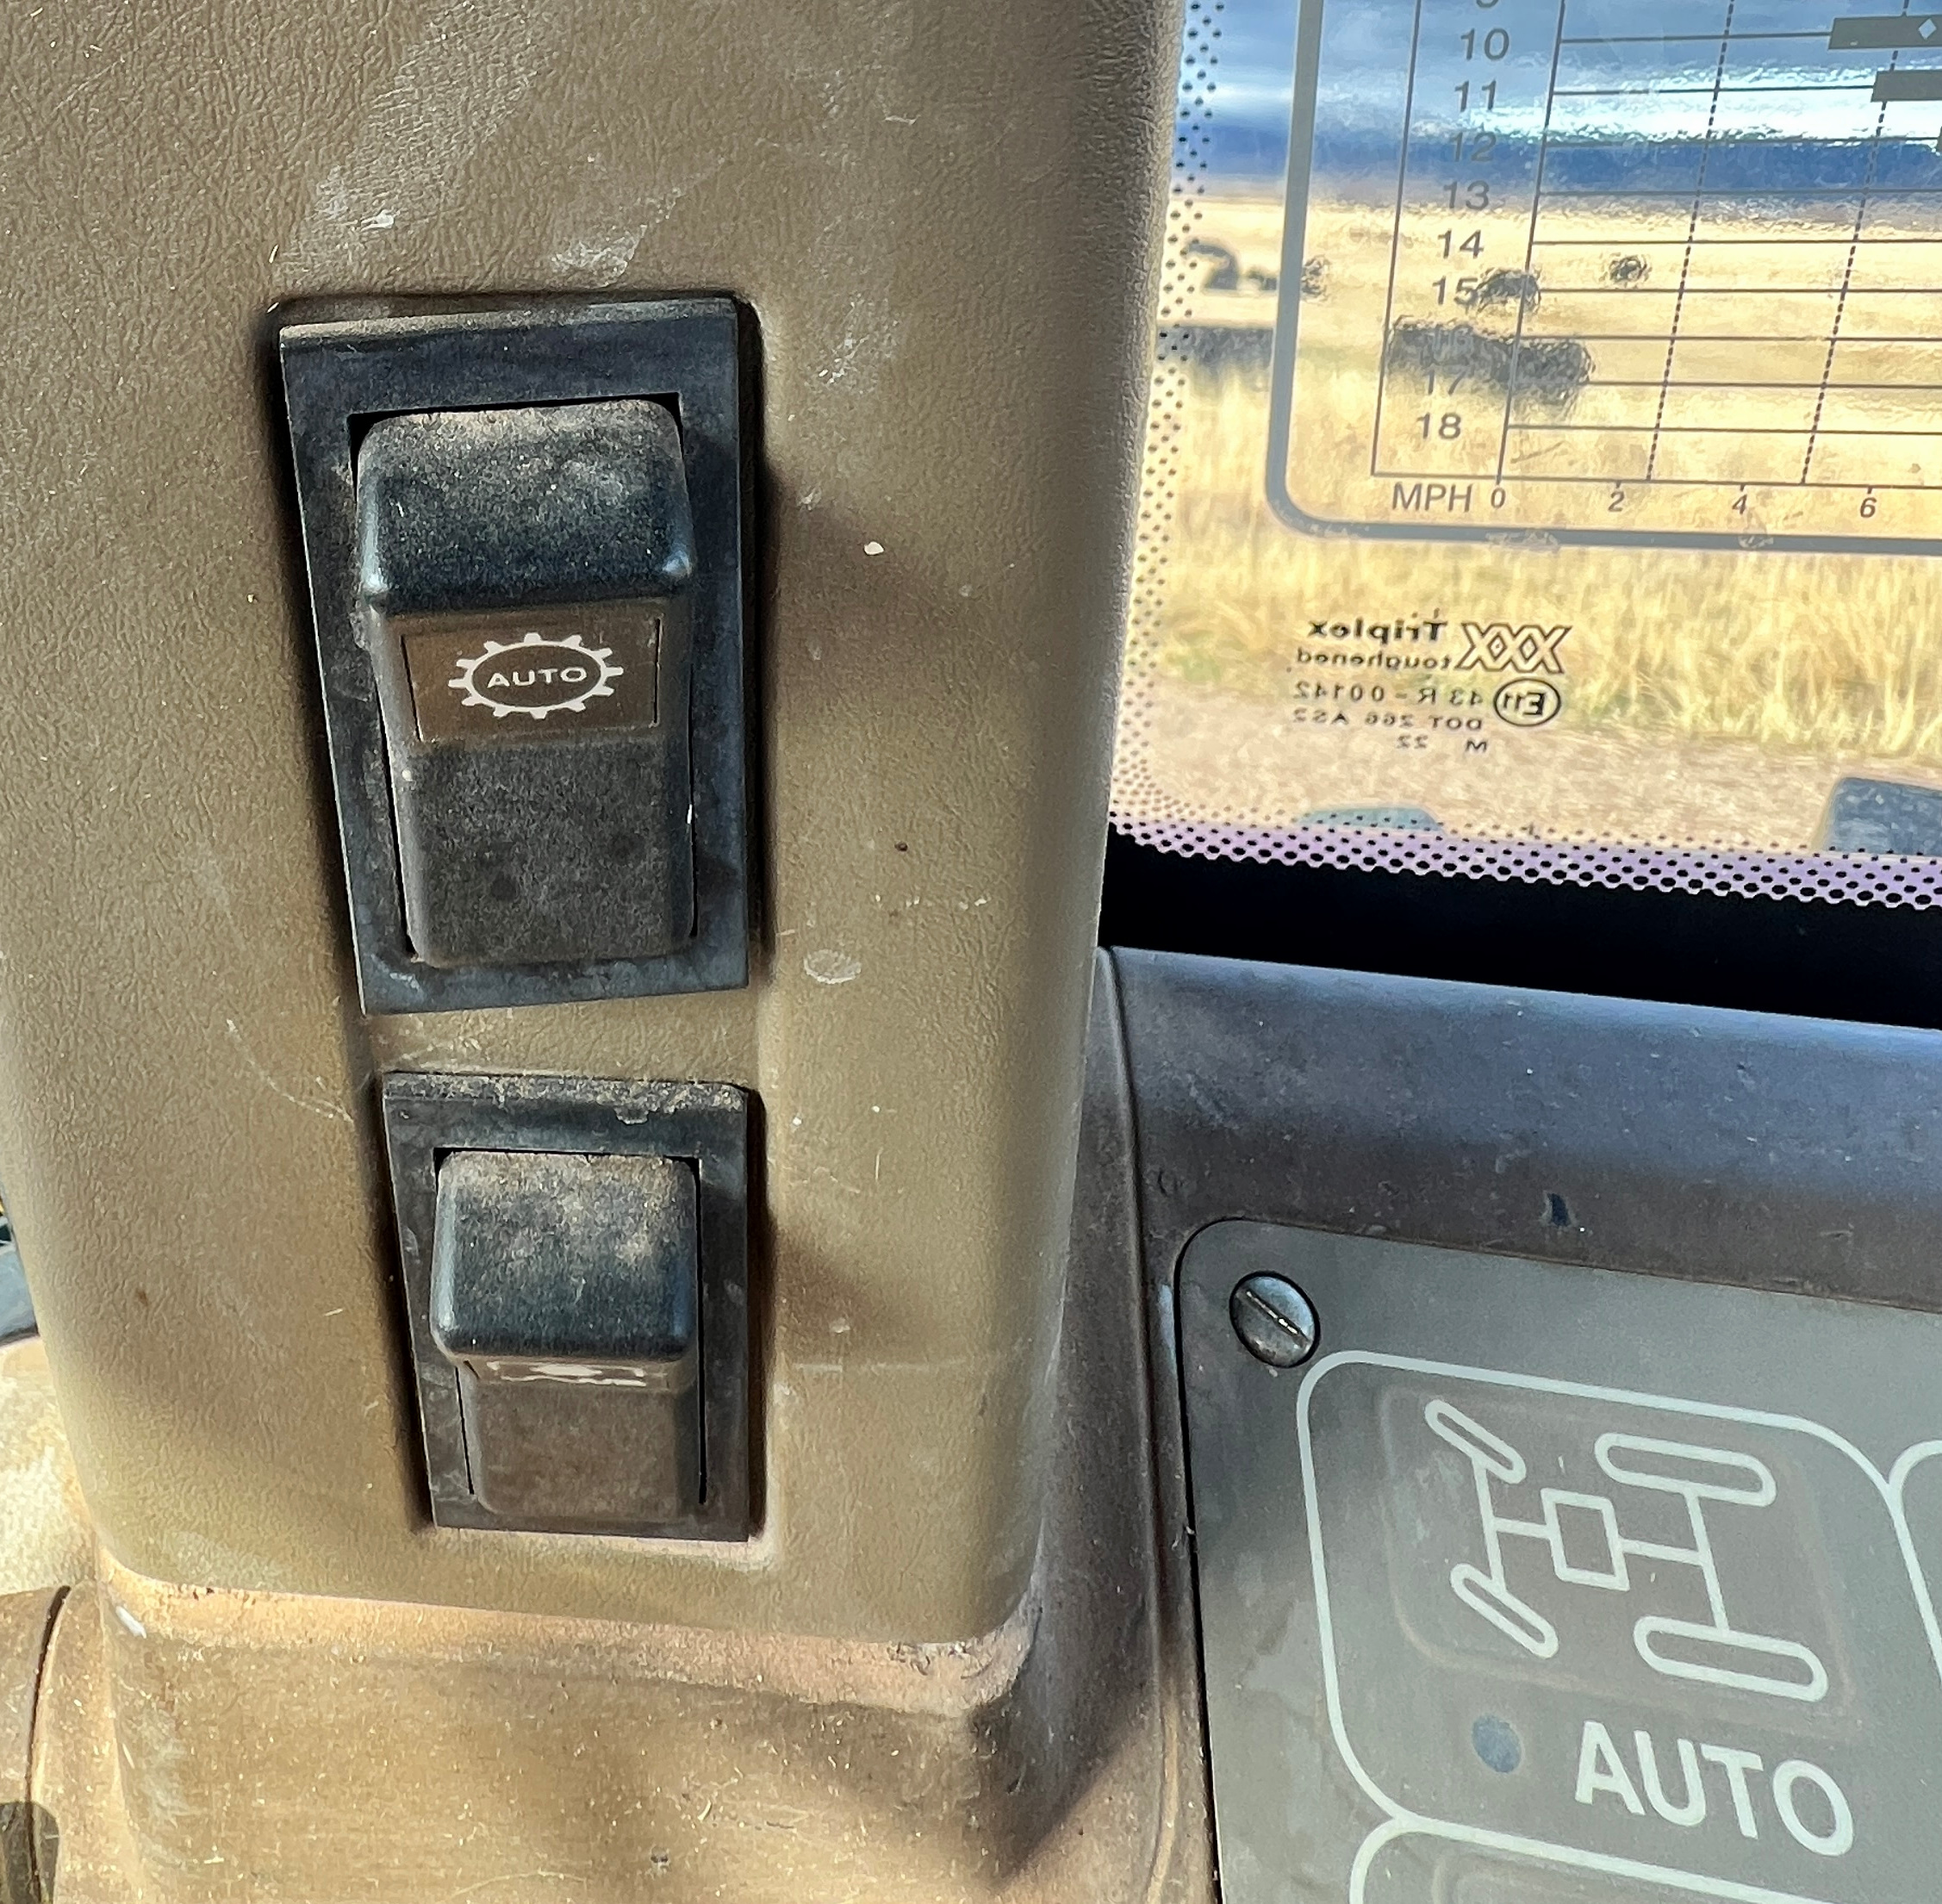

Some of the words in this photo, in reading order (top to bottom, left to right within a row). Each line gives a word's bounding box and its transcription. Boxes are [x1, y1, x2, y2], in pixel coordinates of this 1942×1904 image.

[1460, 28, 1509, 60] 10
[1454, 78, 1497, 112] 11
[1449, 132, 1497, 163] 12
[1443, 180, 1490, 210] 13
[1438, 229, 1484, 259] 14
[1432, 276, 1478, 305] 15
[1425, 363, 1470, 395] 17
[1416, 412, 1461, 439] 18
[1391, 482, 1472, 513] MPH
[1491, 488, 1506, 509] 0
[1608, 492, 1624, 512] 2
[1732, 495, 1748, 515] 4
[1859, 497, 1877, 519] 6
[487, 667, 587, 688] AUTO
[1574, 1720, 1853, 1857] AUTO
